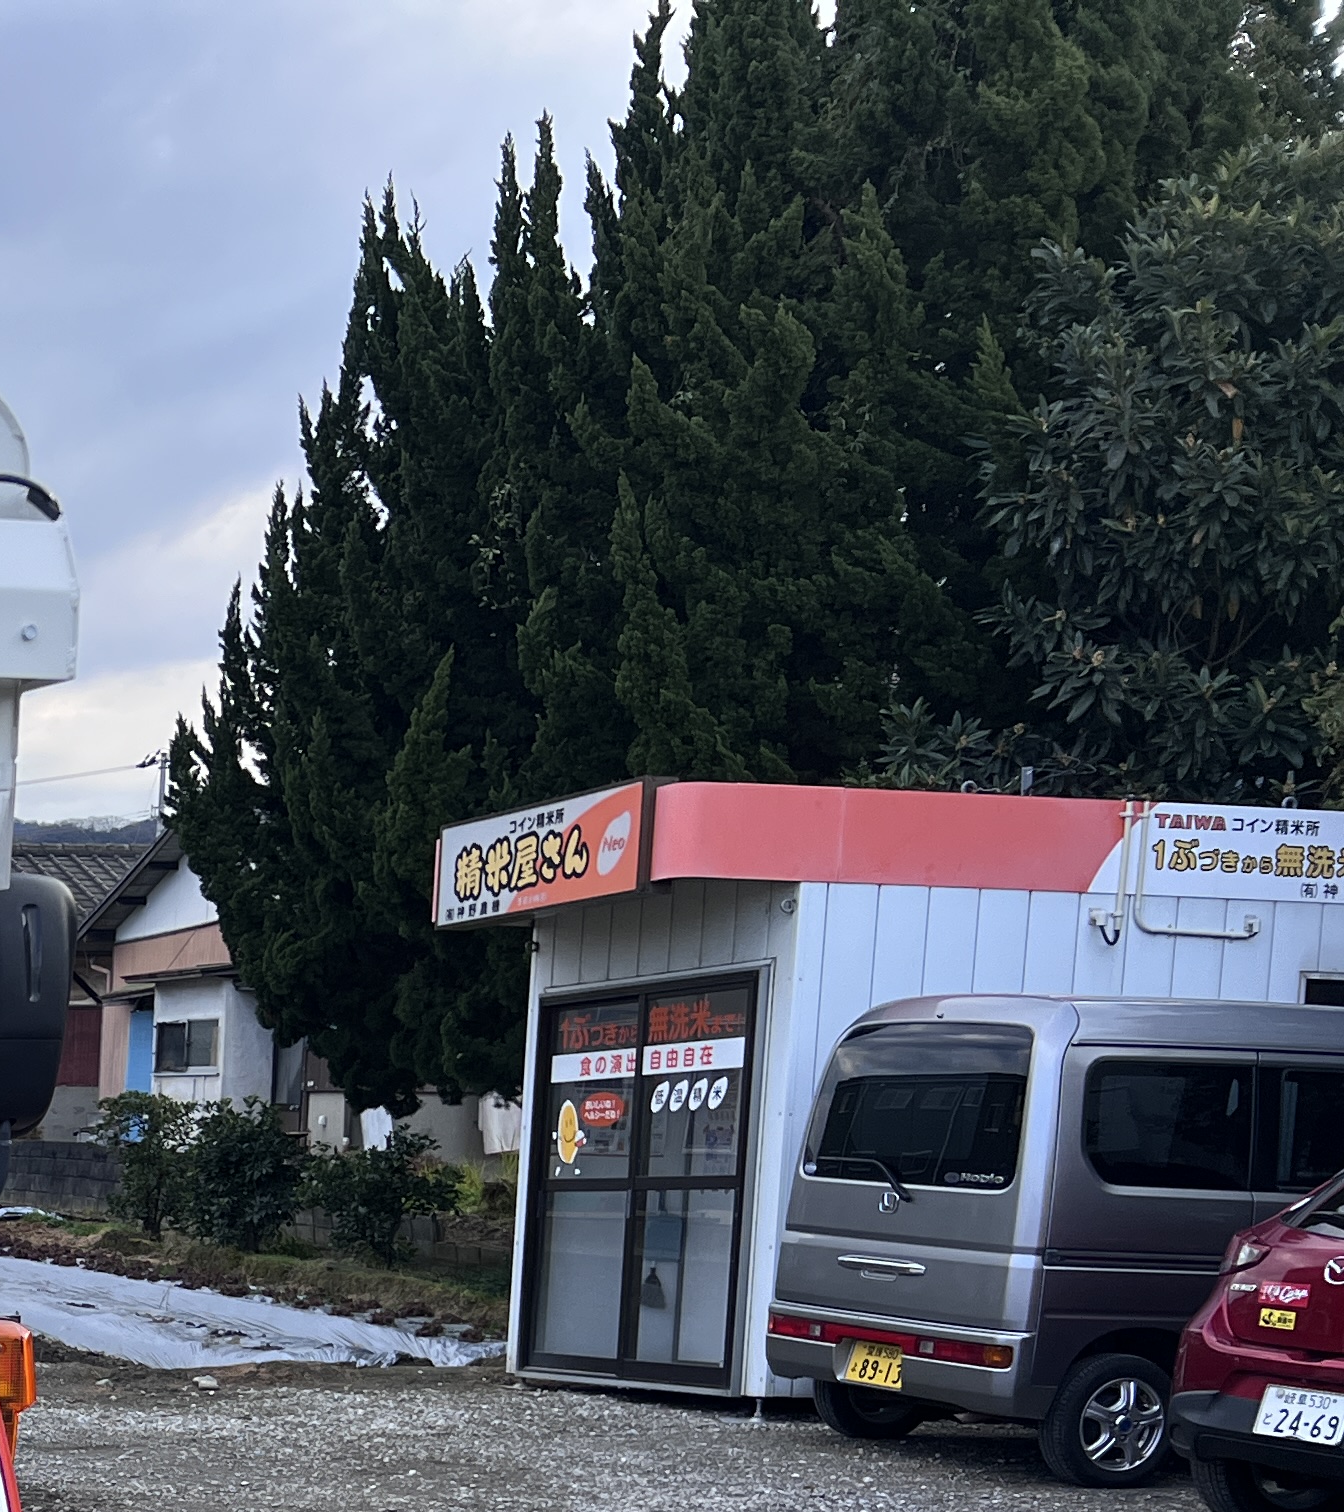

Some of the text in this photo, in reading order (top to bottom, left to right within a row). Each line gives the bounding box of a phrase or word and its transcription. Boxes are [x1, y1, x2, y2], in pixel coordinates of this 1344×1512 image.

[509, 808, 565, 834] コイン精米所
[1155, 813, 1321, 837] TAIWA コイン精米所
[454, 824, 589, 900] 精米屋さん
[650, 1045, 714, 1070] 自由自在
[1263, 1409, 1340, 1441] と 24-69
